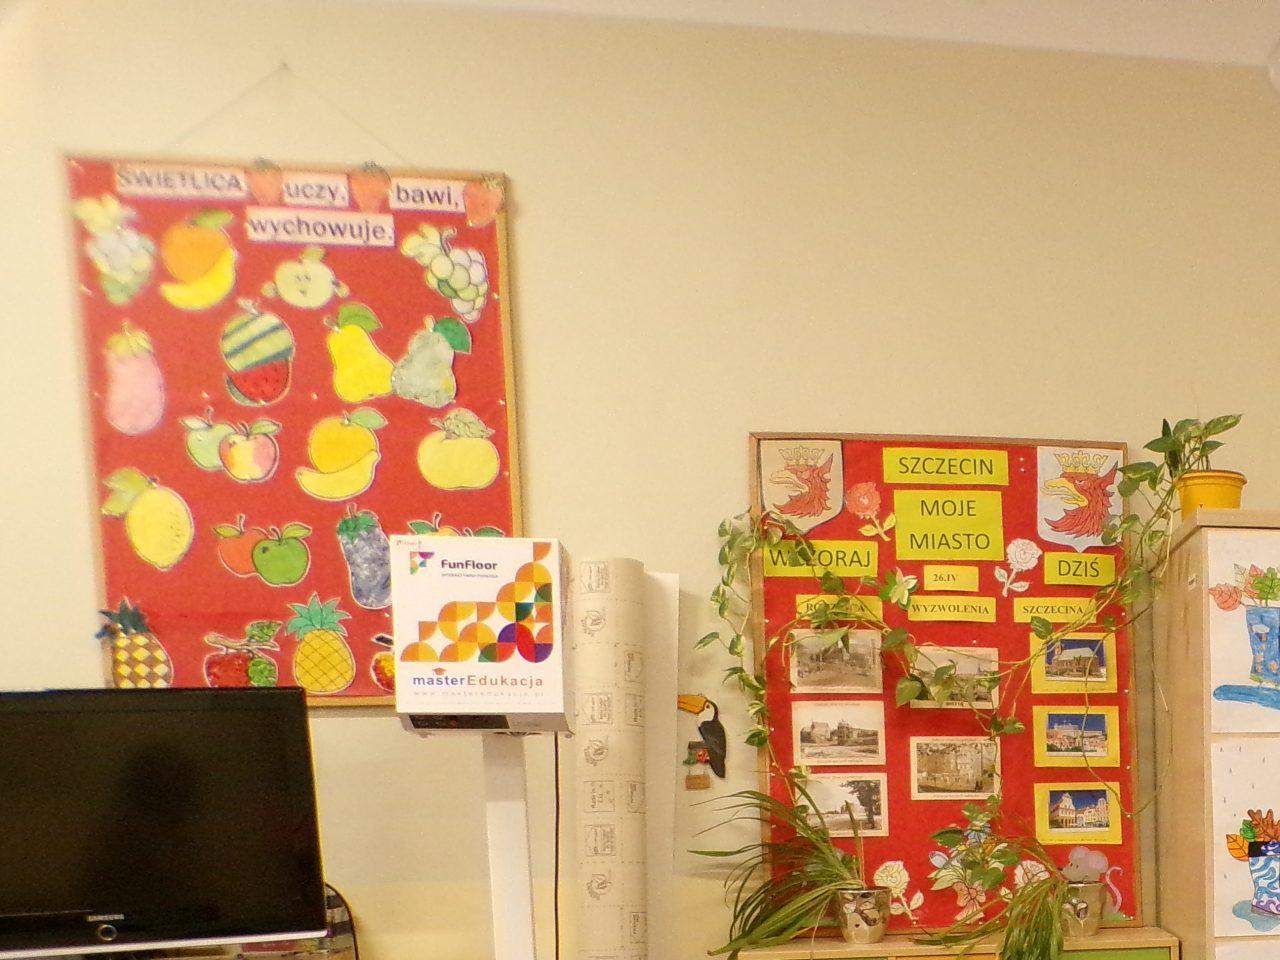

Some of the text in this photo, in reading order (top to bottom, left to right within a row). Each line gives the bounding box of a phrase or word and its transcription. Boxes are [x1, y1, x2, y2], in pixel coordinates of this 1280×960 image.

[396, 183, 459, 209] bawi,
[898, 456, 994, 476] SZCZECIN
[920, 499, 977, 518] MOJE
[910, 532, 990, 550] MIASTO
[441, 559, 498, 571] FunFloor
[1058, 557, 1100, 579] DZIŚ
[933, 573, 958, 582] 26.IV
[912, 604, 989, 615] WYZWOLENIA
[1023, 605, 1083, 615] SZCZECINA
